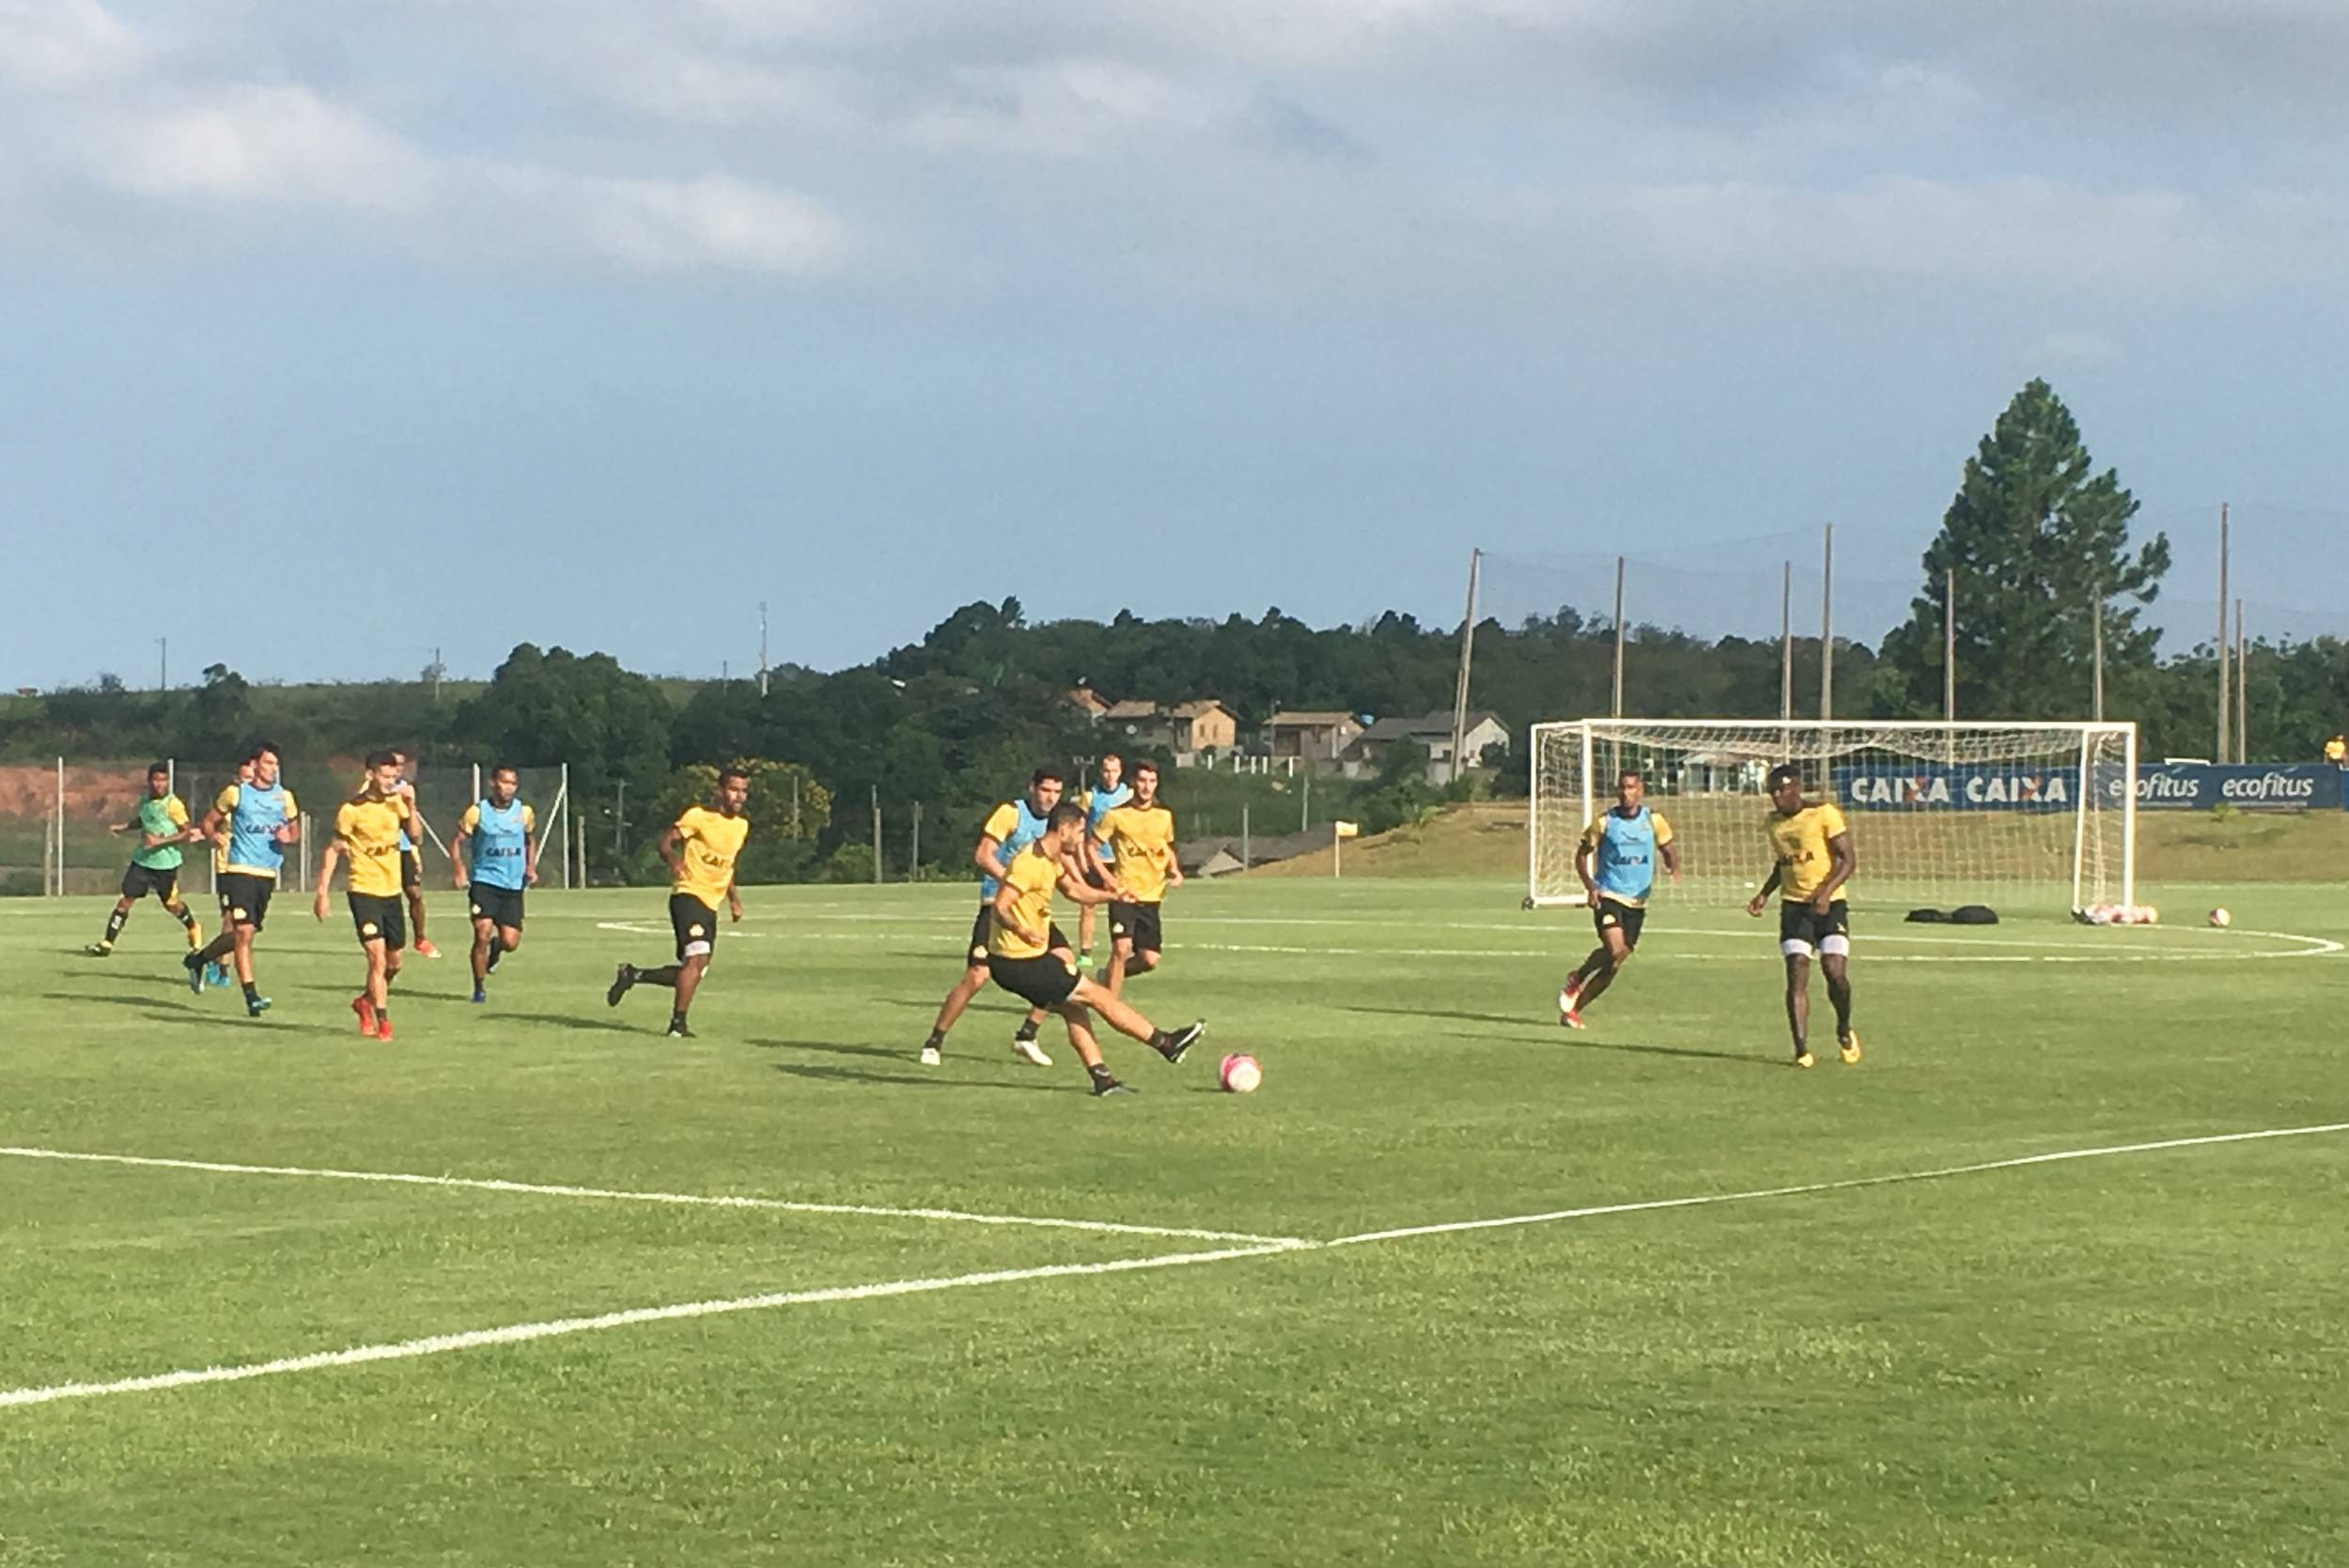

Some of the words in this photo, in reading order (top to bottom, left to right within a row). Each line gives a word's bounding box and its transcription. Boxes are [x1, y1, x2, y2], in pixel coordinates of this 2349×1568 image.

[1851, 776, 1950, 803] CAIXA
[1966, 775, 2068, 803] CAIXA
[2108, 771, 2200, 800] eofitus
[2221, 771, 2313, 800] ecofitus
